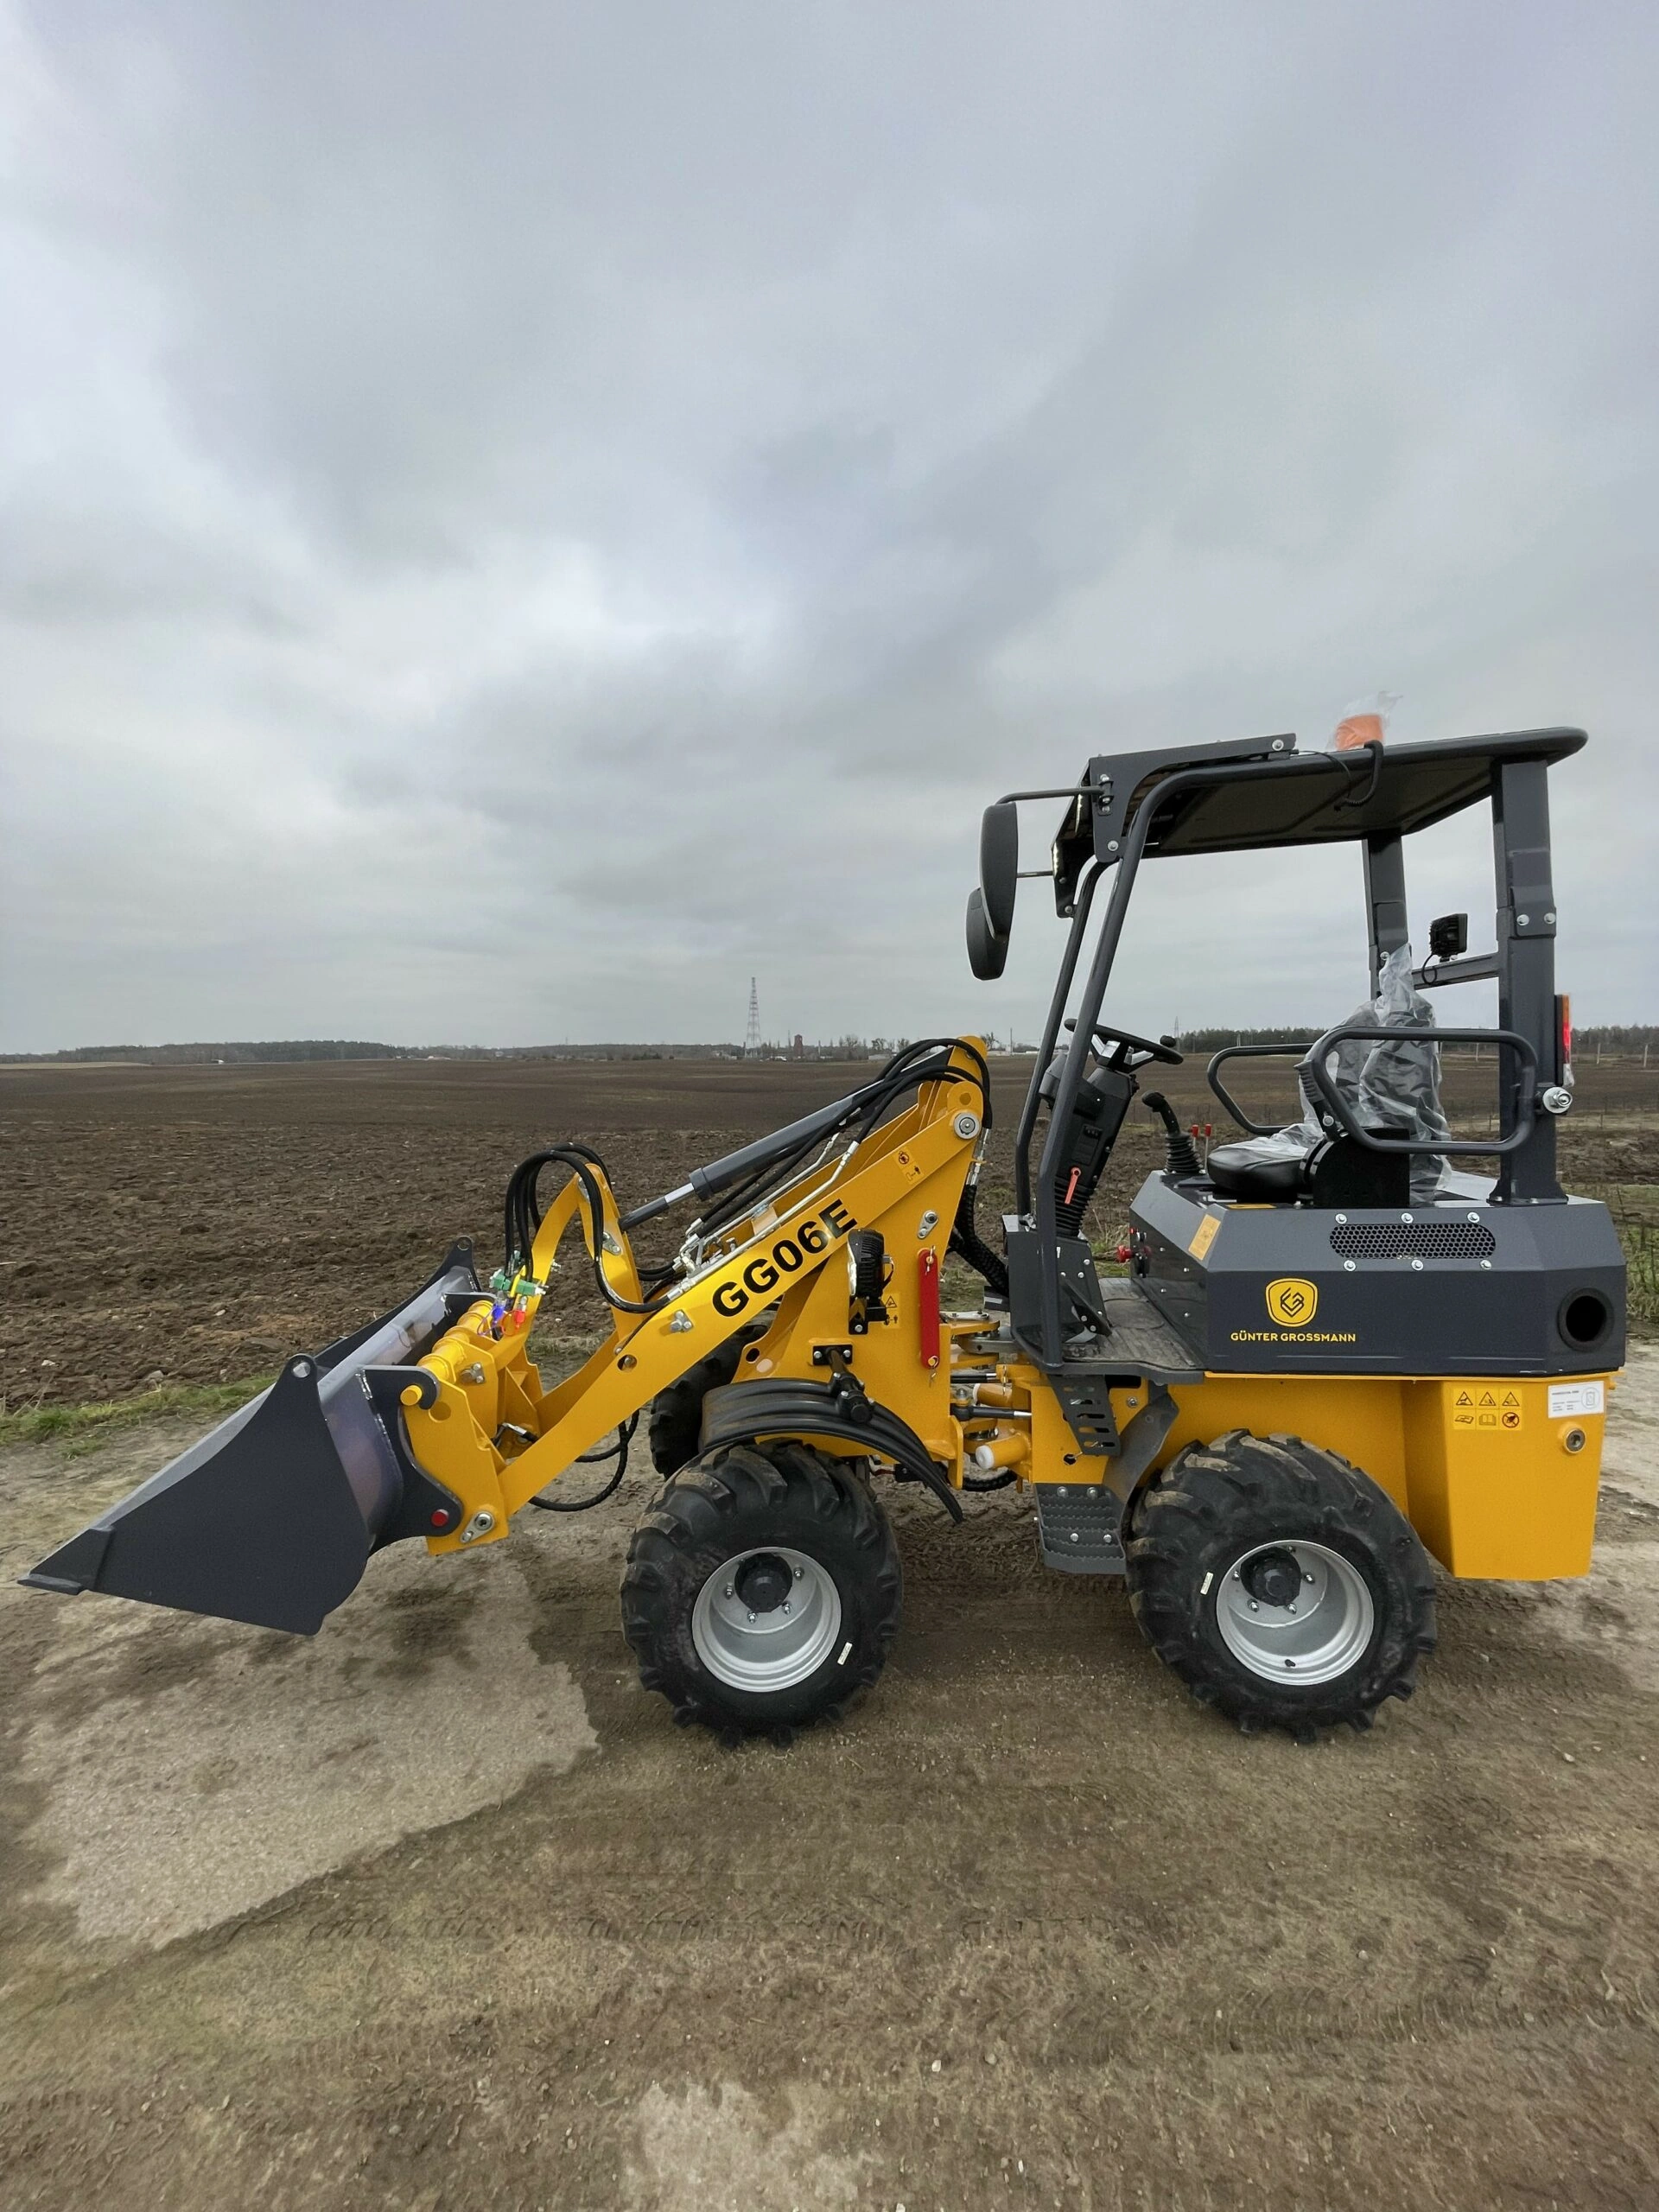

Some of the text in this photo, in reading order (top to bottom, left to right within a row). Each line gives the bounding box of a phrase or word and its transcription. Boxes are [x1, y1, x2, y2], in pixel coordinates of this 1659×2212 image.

[712, 1198, 858, 1317] GG06E
[1230, 1330, 1356, 1342] GÜNTER GROSSMANN
